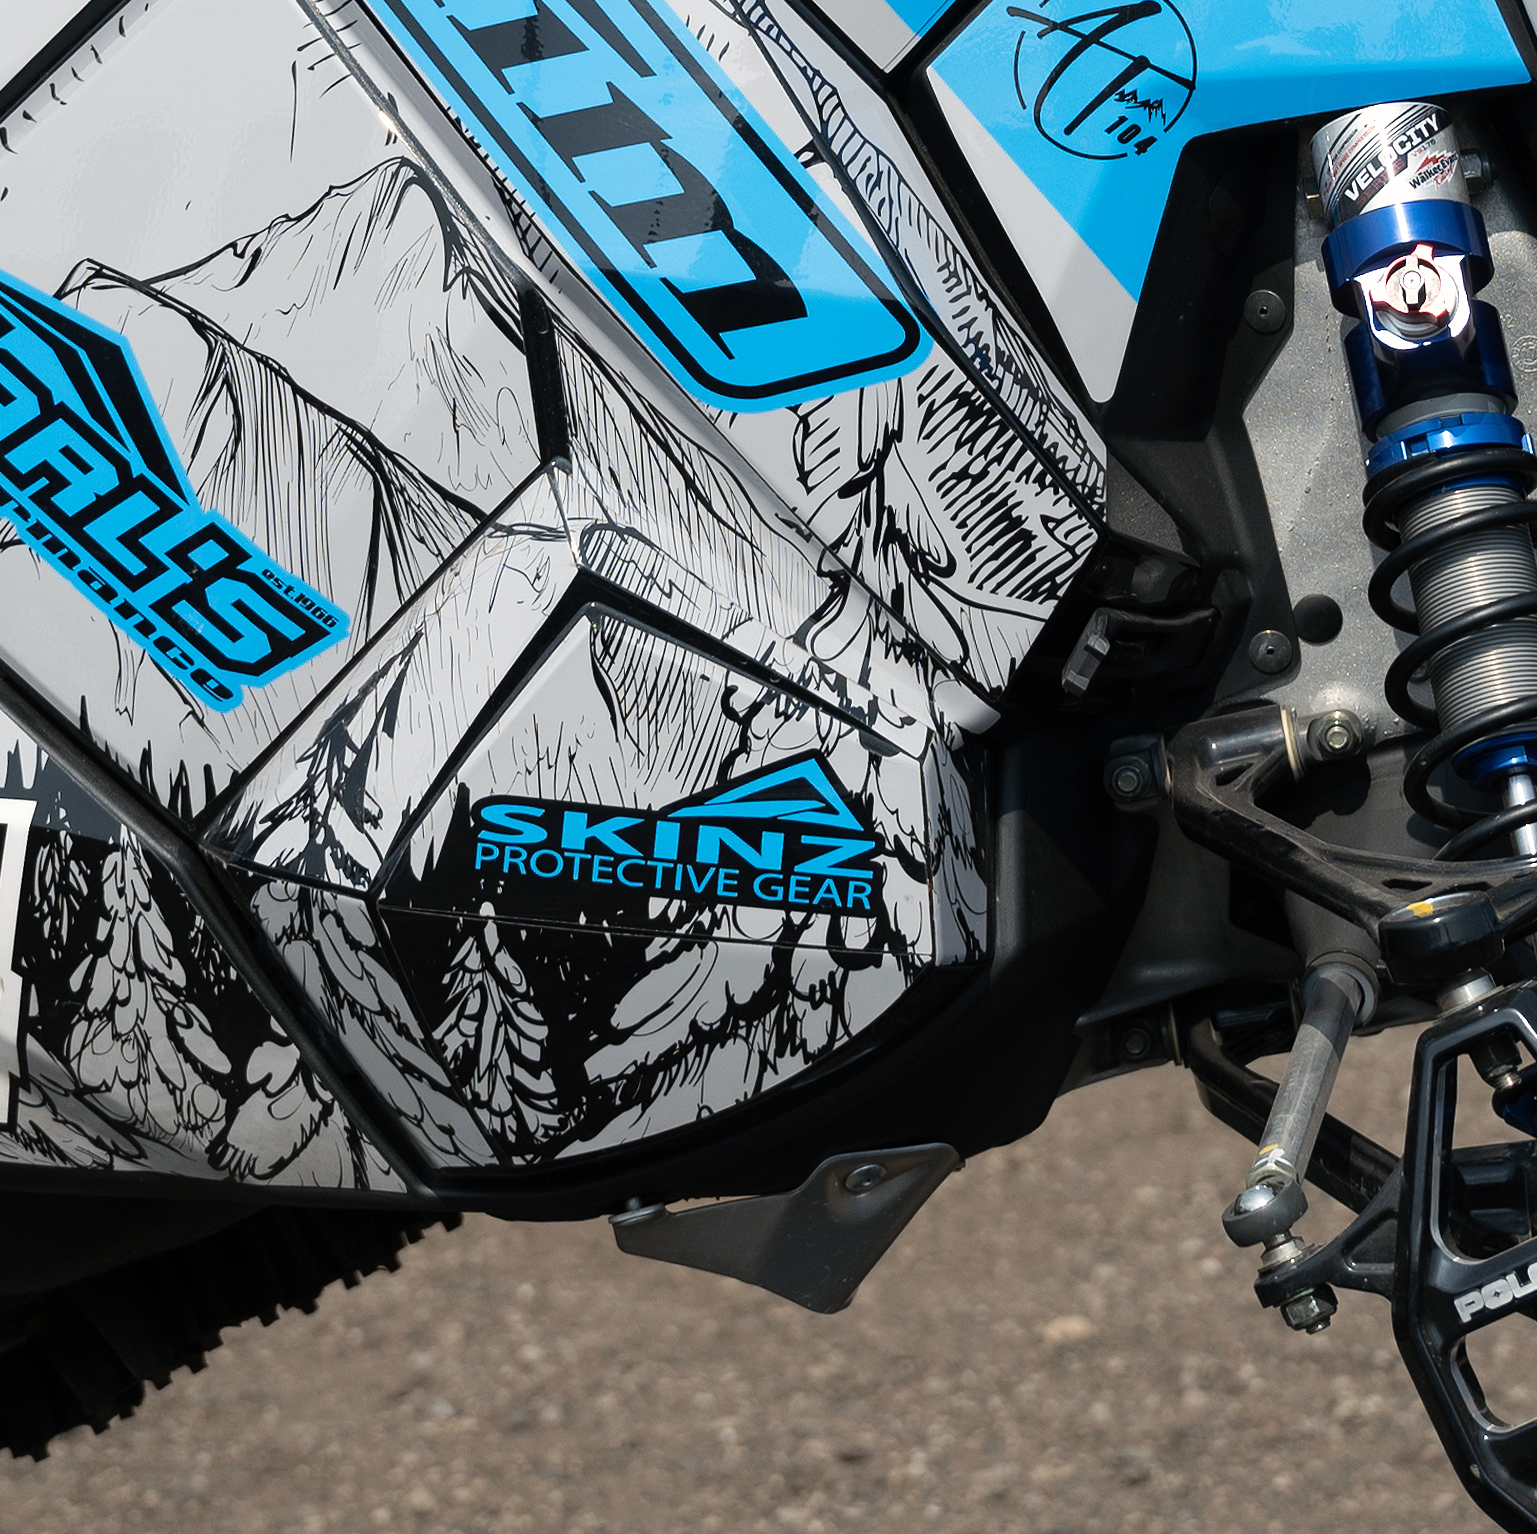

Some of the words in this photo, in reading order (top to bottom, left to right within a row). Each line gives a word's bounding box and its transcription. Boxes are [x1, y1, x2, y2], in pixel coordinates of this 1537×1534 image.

[1103, 115, 1158, 156] 104
[1344, 114, 1440, 202] VELOCITY
[1356, 158, 1405, 206] SERIS
[261, 568, 340, 629] est.1966
[477, 803, 875, 880] SKINZ
[474, 842, 740, 898] PROTECTIVE
[752, 872, 872, 910] GEAR
